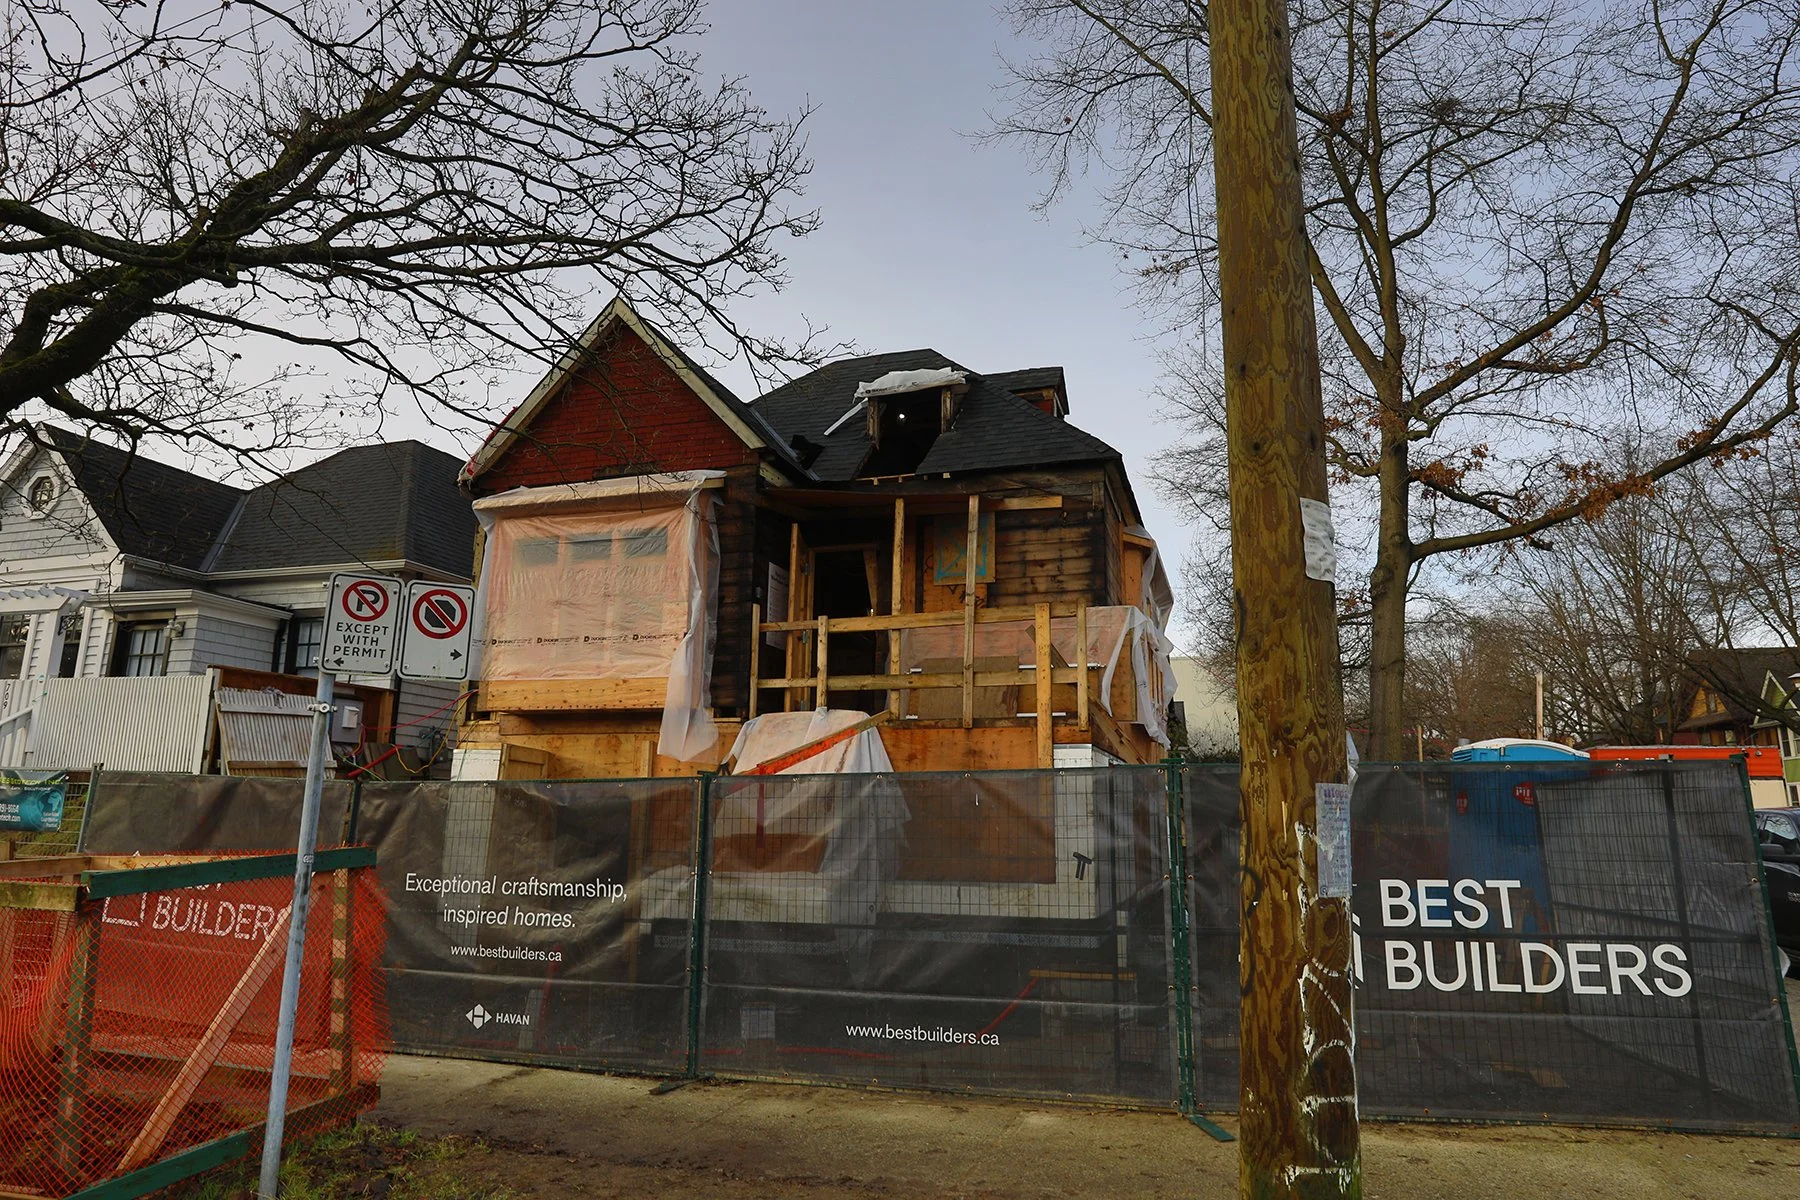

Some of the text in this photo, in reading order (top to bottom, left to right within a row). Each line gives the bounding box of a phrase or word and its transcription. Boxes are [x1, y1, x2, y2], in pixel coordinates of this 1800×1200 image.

[336, 622, 389, 636] EXCEPT
[342, 634, 379, 646] WITH
[333, 645, 386, 659] PERMIT
[3, 683, 11, 710] 709
[405, 873, 628, 903] Exceptional craftsmanship,
[1379, 878, 1521, 929] BEST
[443, 904, 576, 929] inspired homes.
[450, 945, 562, 962] www.bestbuilders.ca
[1384, 940, 1693, 997] BUILDERS
[495, 1013, 530, 1026] HAVAN
[845, 1024, 1000, 1046] www.bestbuilders.ca
